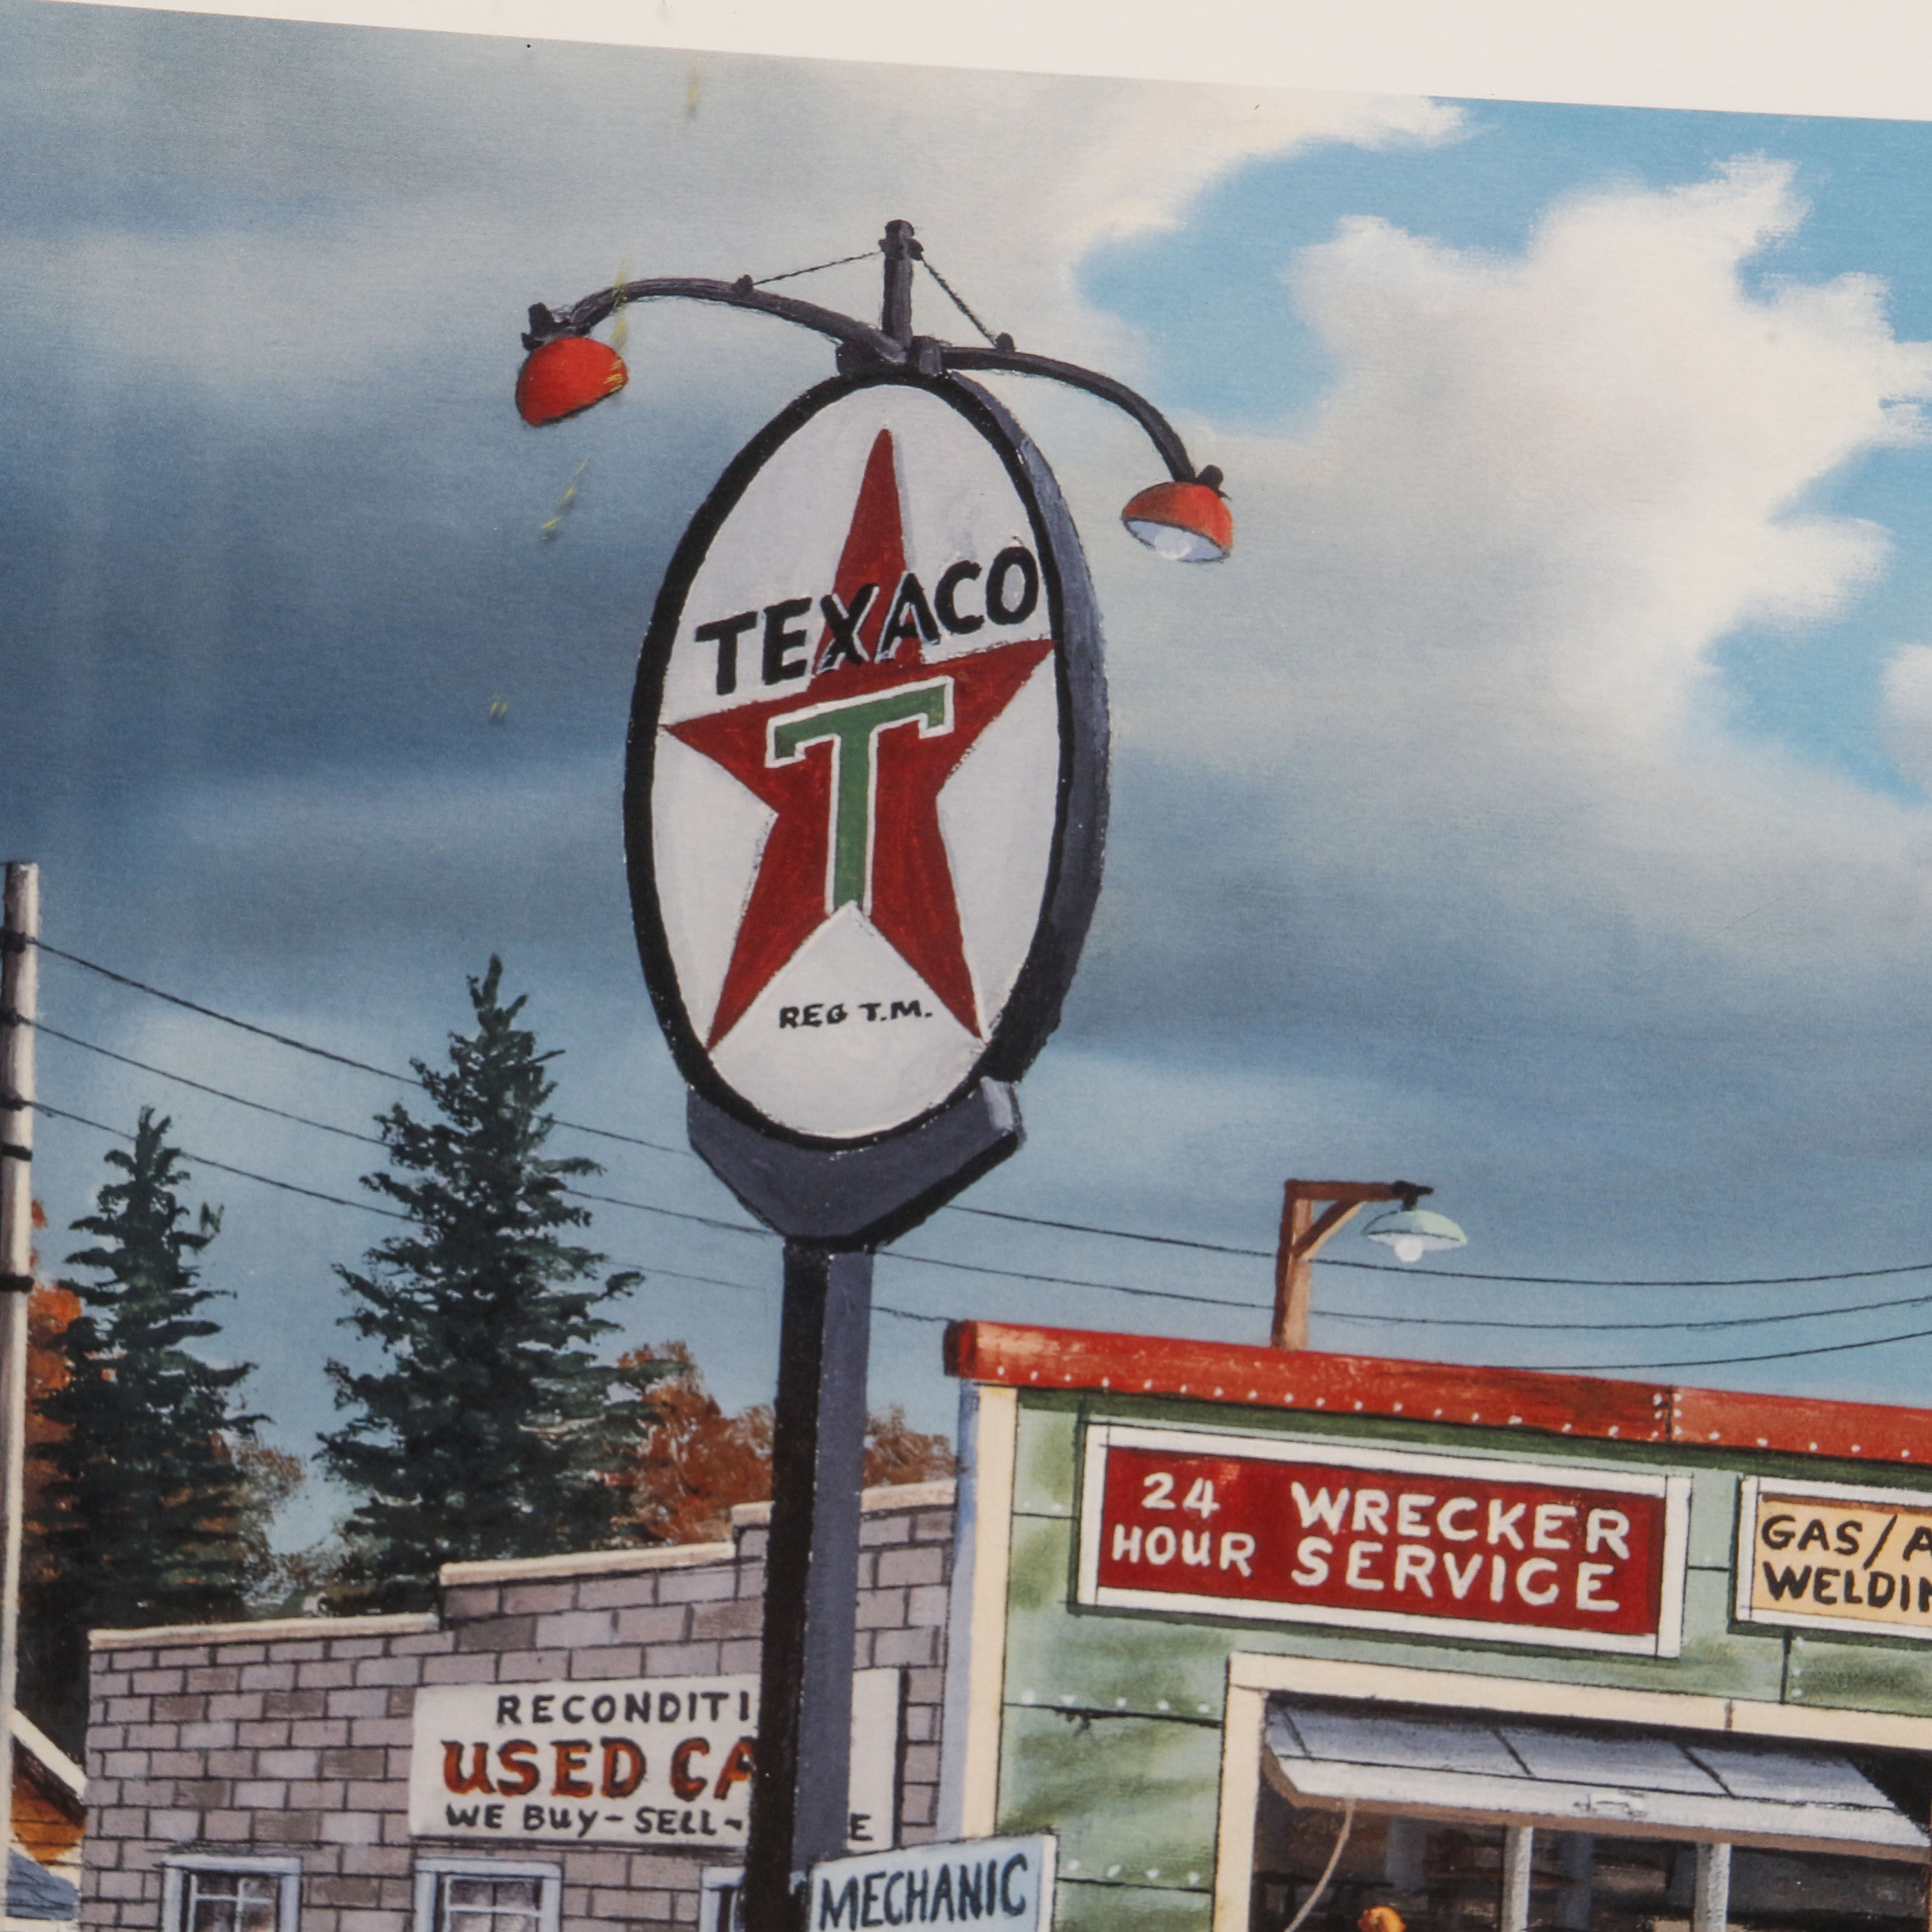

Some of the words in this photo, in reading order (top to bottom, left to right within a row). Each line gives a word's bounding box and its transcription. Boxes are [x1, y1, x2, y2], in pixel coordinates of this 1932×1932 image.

[695, 545, 1039, 695] TEXACO
[764, 675, 954, 916] T
[780, 1003, 847, 1028] REG
[858, 1000, 932, 1021] T.M.
[1141, 1472, 1220, 1519] 24
[1291, 1480, 1631, 1560] WRECKER
[1112, 1524, 1256, 1577] HOUR
[1291, 1536, 1620, 1612] SERVICE
[441, 1736, 646, 1799] USED
[446, 1803, 504, 1829] WE
[819, 1853, 1027, 1931] MECHANIC
